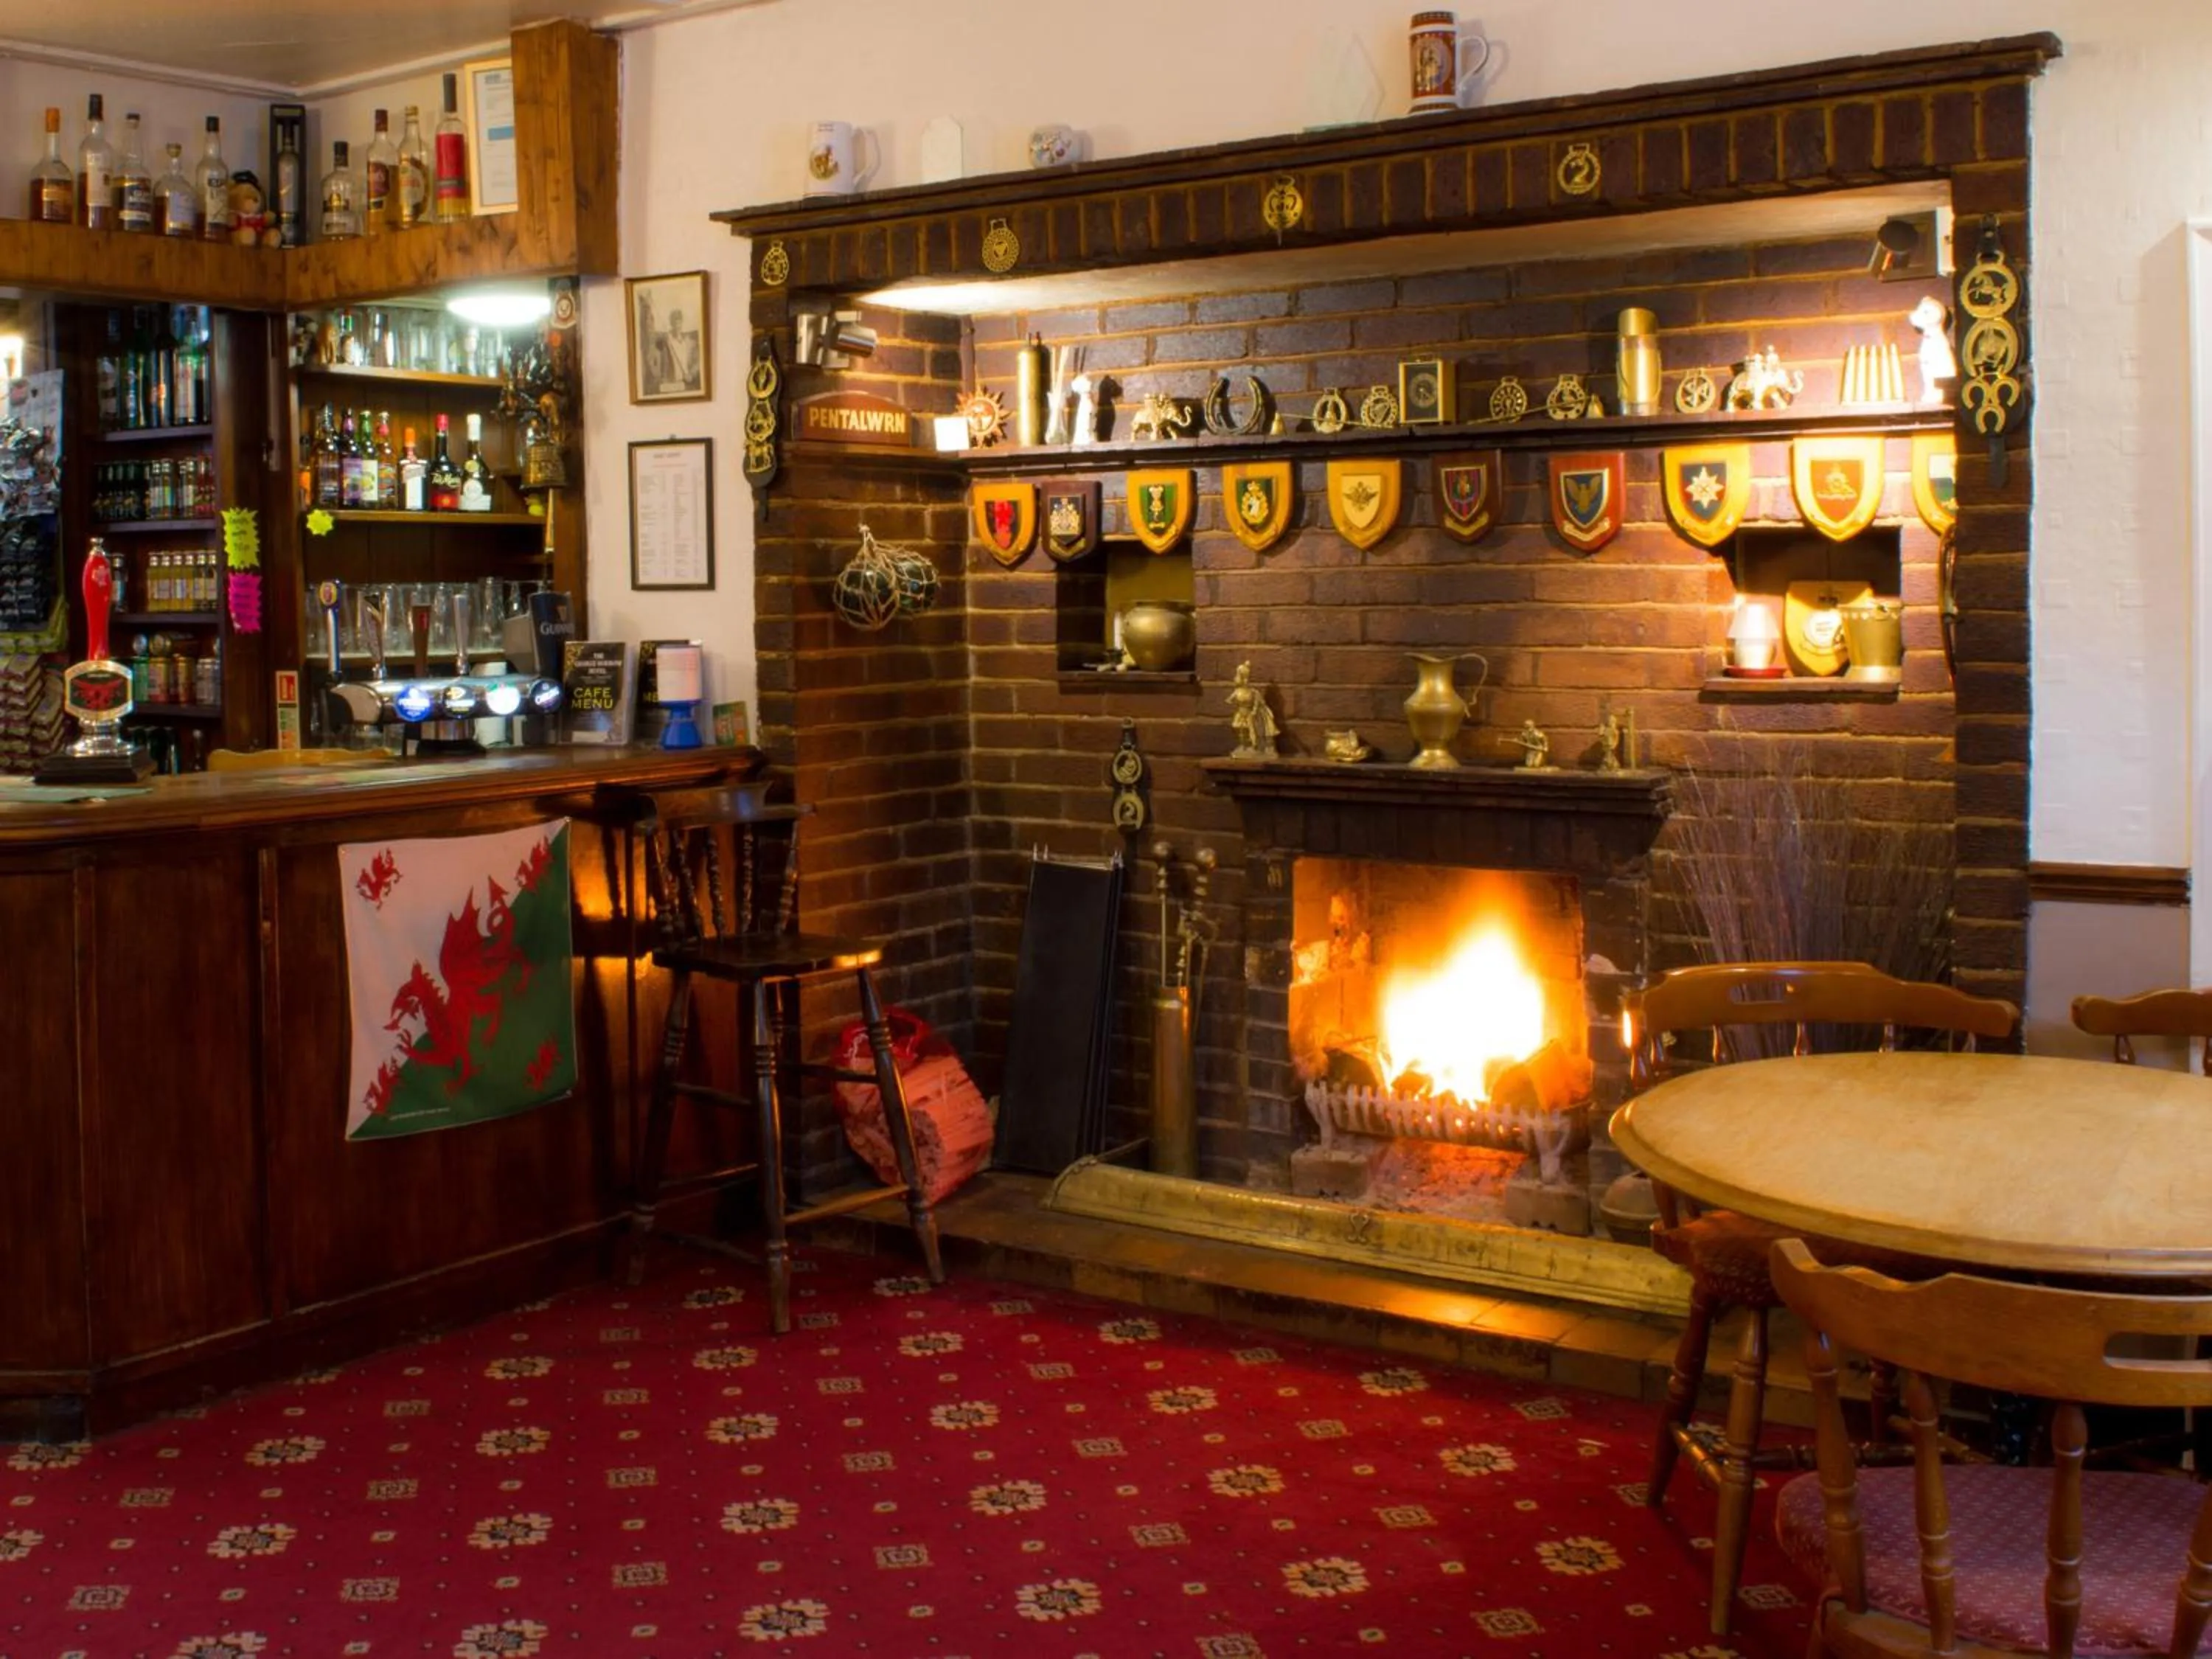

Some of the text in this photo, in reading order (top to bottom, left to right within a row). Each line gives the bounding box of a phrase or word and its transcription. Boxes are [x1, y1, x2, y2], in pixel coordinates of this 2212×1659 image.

[808, 406, 906, 434] PENTALWRN
[574, 686, 612, 698] CAFE
[571, 698, 614, 709] MENU
